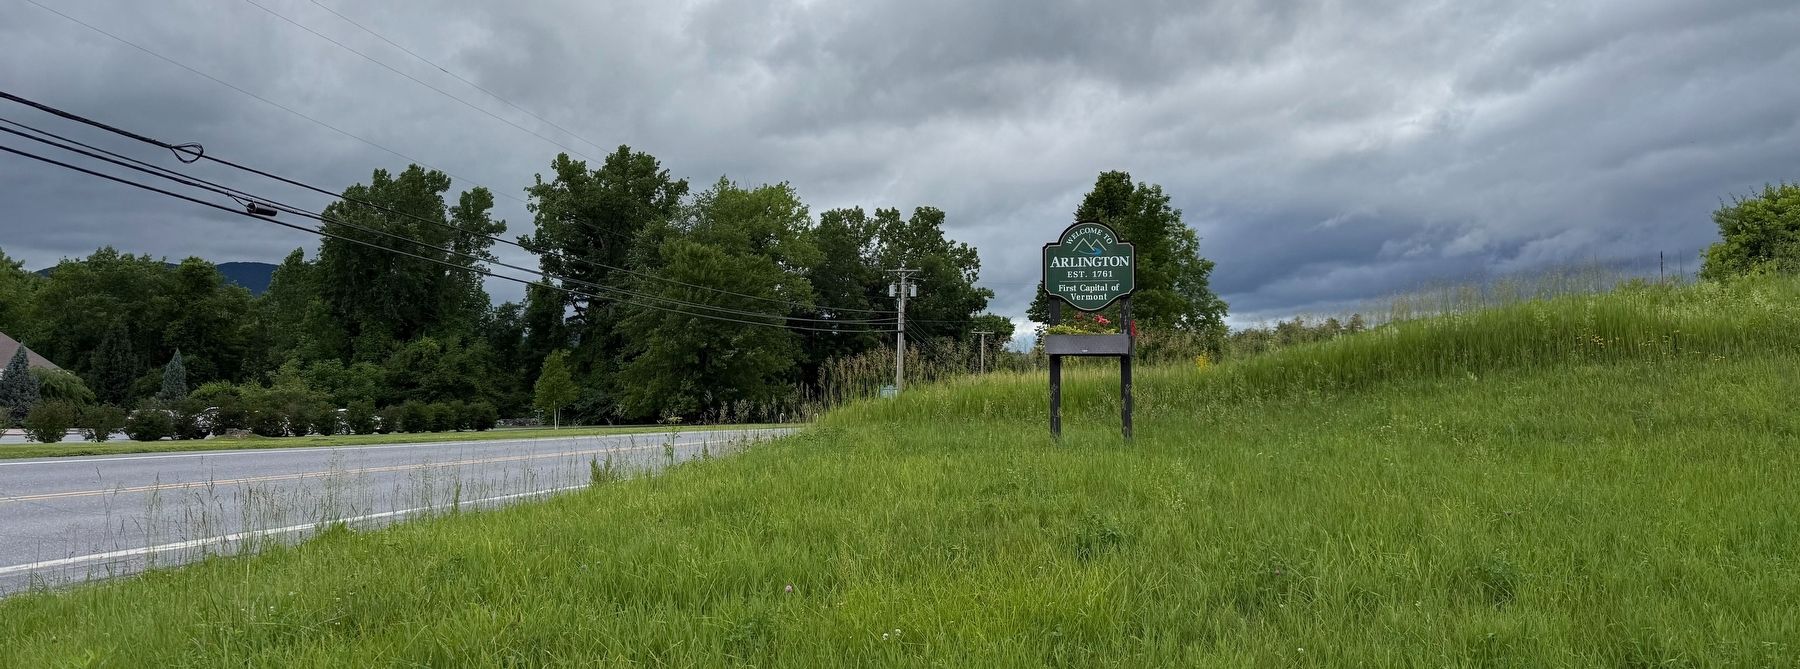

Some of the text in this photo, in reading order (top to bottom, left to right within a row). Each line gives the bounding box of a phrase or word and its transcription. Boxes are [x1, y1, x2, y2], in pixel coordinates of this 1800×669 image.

[1066, 227, 1113, 244] WELCOME TO
[1050, 256, 1130, 268] ARLINGTON
[1080, 284, 1108, 293] Capital
